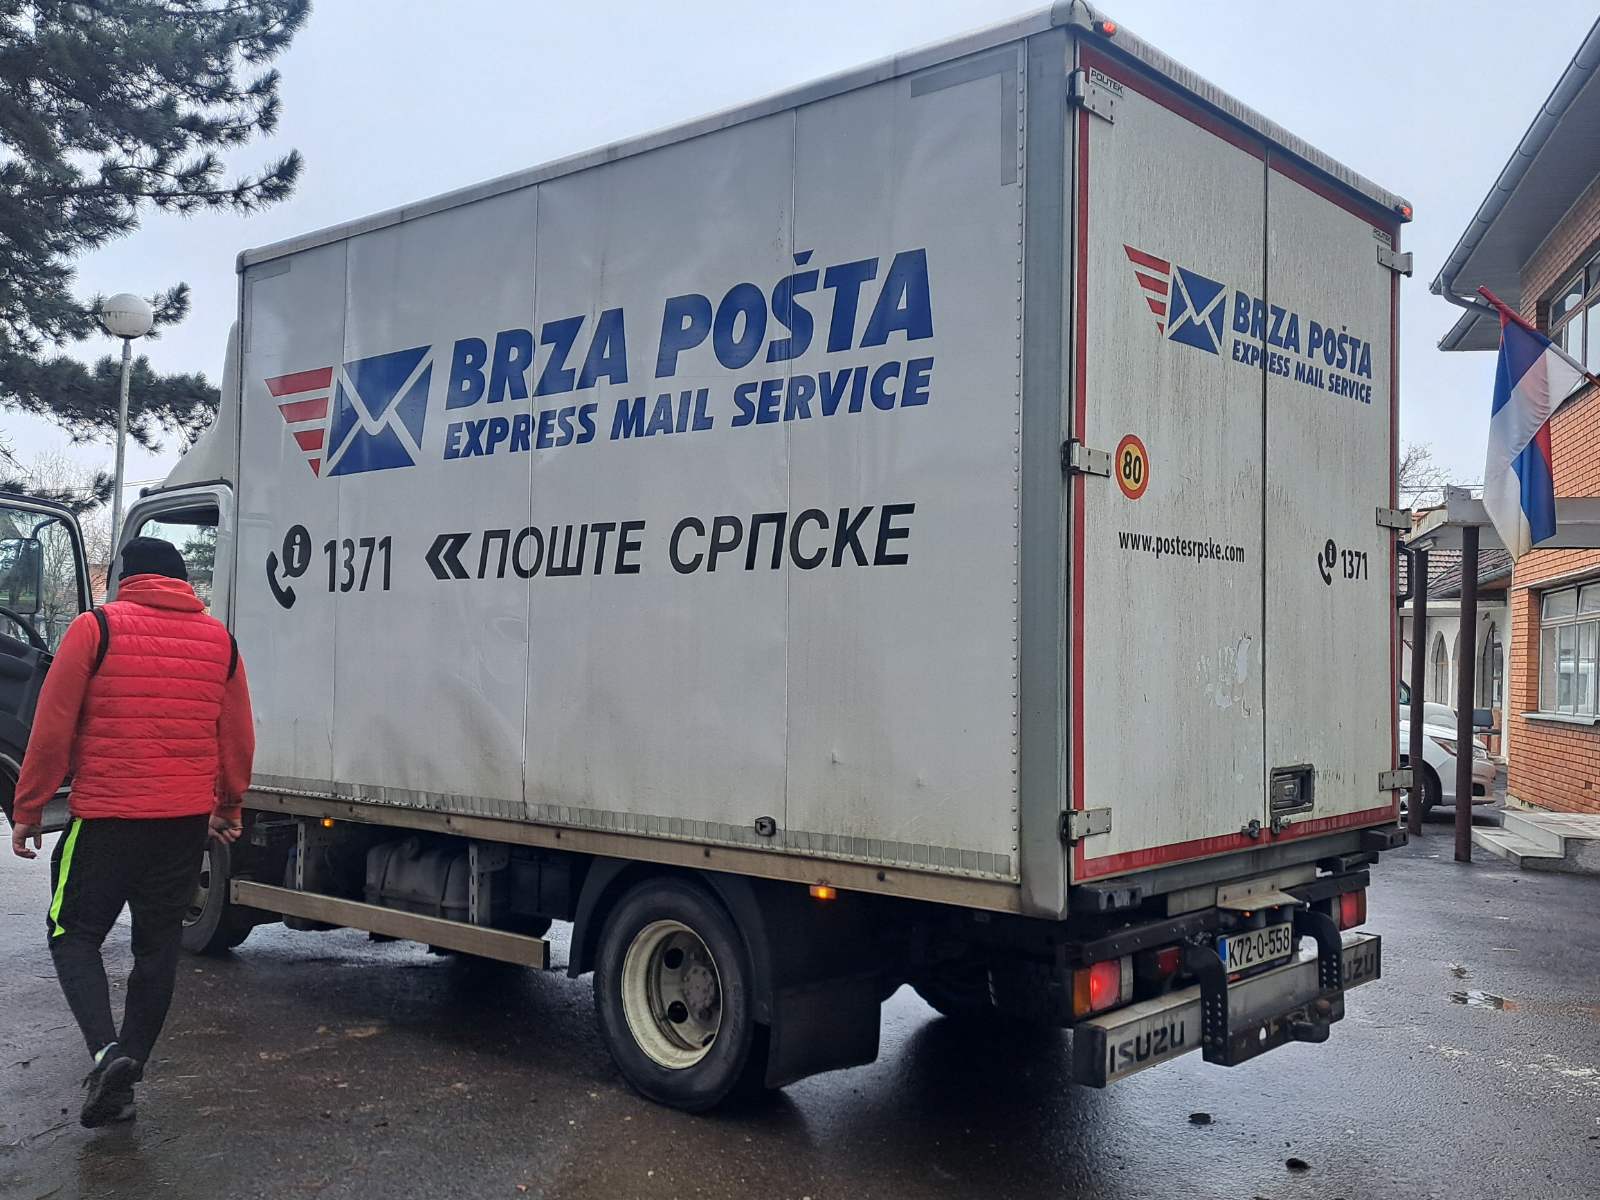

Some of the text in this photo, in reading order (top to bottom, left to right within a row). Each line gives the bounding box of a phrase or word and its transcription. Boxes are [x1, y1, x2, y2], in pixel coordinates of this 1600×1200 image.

[445, 247, 934, 410] BRZA POŠTA
[1232, 290, 1372, 379] BRZA POŠTA
[1232, 339, 1372, 404] EXPRESS MAIL SERVICE
[443, 356, 935, 459] EXPRESS MAIL SERVICE
[1122, 450, 1142, 485] 80
[324, 535, 393, 593] 1371
[476, 502, 916, 580] ПОШТЕ СРПСКЕ
[1118, 531, 1246, 564] www.postesrpske.com
[1341, 549, 1369, 581] 1371
[1342, 953, 1375, 981] UZU
[1109, 1020, 1185, 1074] ISUZU
